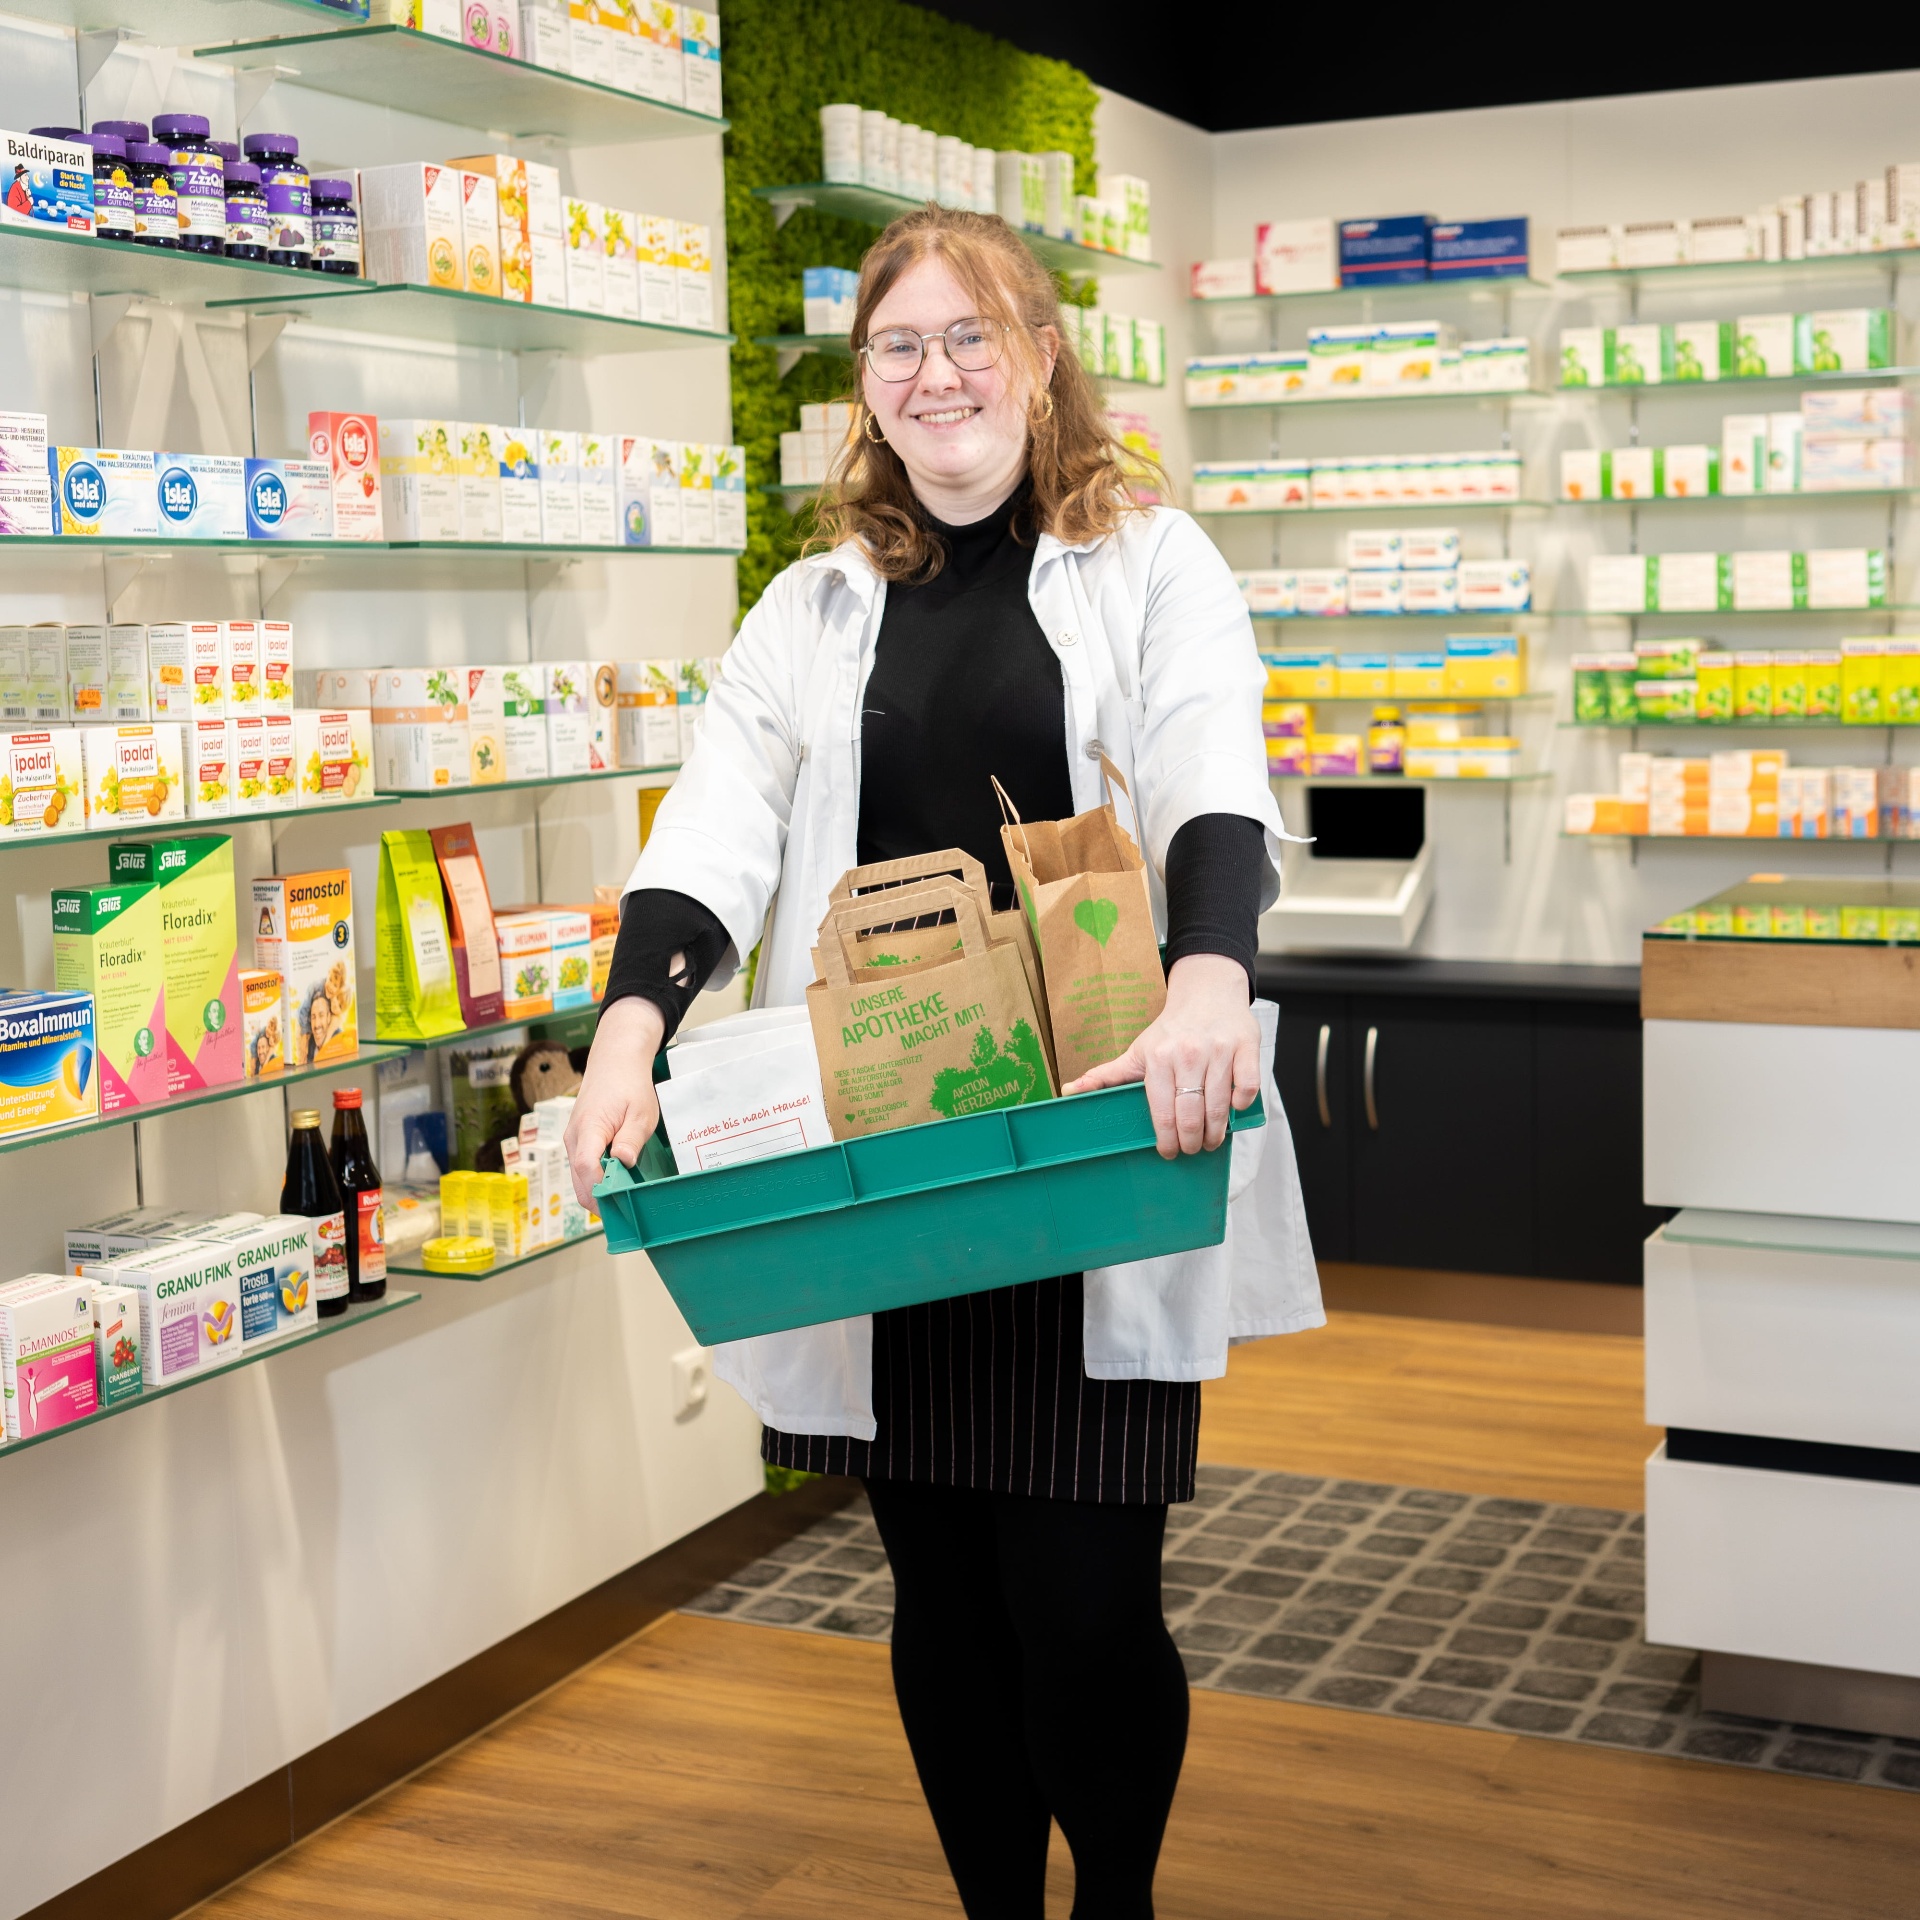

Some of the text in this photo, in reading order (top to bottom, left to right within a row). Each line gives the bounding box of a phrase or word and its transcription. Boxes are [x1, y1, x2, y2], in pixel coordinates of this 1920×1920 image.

[8, 140, 84, 167] Baldriparan
[189, 186, 210, 194] GUTE
[344, 432, 366, 453] isla
[96, 460, 107, 468] UND
[70, 476, 100, 500] isla
[164, 482, 191, 504] isla
[256, 486, 281, 508] isla
[196, 642, 216, 653] ipalat
[233, 640, 253, 651] ipalat
[268, 639, 287, 650] ipalat
[202, 740, 223, 750] ipalat
[241, 737, 262, 748] ipalat
[270, 735, 290, 746] ipalat
[322, 730, 348, 746] ipalat
[15, 752, 52, 773] ipalat
[121, 746, 153, 764] ipalat
[121, 783, 154, 792] Honigmild
[18, 793, 50, 802] Zuckerfrei
[116, 853, 146, 870] Salus
[159, 850, 186, 870] Salus
[290, 880, 344, 902] sanostol
[54, 899, 80, 914] Salus
[96, 896, 121, 915] Salus
[162, 898, 197, 910] Kräuterblut
[290, 904, 318, 918] MULTI-
[163, 909, 213, 930] Floradix
[290, 914, 330, 931] VITAMINE
[164, 935, 193, 945] MIT EISEN
[338, 927, 345, 942] 3
[514, 932, 547, 945] HEUMANN
[557, 925, 586, 938] HEUMANN
[99, 938, 134, 950] Kräuterblut
[100, 950, 142, 968] Floradix
[246, 979, 277, 992] sanostol
[850, 985, 908, 1017] UNSERE
[841, 992, 948, 1048] APOTHEKE
[900, 1002, 986, 1050] MACHT MIT!
[29, 1037, 40, 1047] und
[42, 1030, 82, 1044] Mineralstoffe
[834, 1054, 923, 1078] DIESE TASCHE UNTERSTÜTZT
[852, 1070, 898, 1084] AUFFORSTUNG
[838, 1077, 903, 1096] DEUTSCHER WÄLDER
[952, 1077, 989, 1099] AKTION
[848, 1090, 884, 1103] UND SOMIT
[952, 1079, 1021, 1116] HERZBAUM
[857, 1100, 909, 1117] DIE BIOLOGISCHE
[678, 1094, 811, 1145] ...direkt bis nach Hause!
[864, 1113, 890, 1125] VIELFALT
[687, 1189, 738, 1208] SOFORT
[237, 1232, 308, 1268] GRANU FINK
[157, 1261, 232, 1299] GRANU FINK
[242, 1273, 268, 1290] Prosta
[243, 1294, 258, 1307] forte
[160, 1302, 195, 1324] femina
[20, 1326, 78, 1356] D-MANNOSE
[108, 1366, 140, 1384] CRANBERRY
